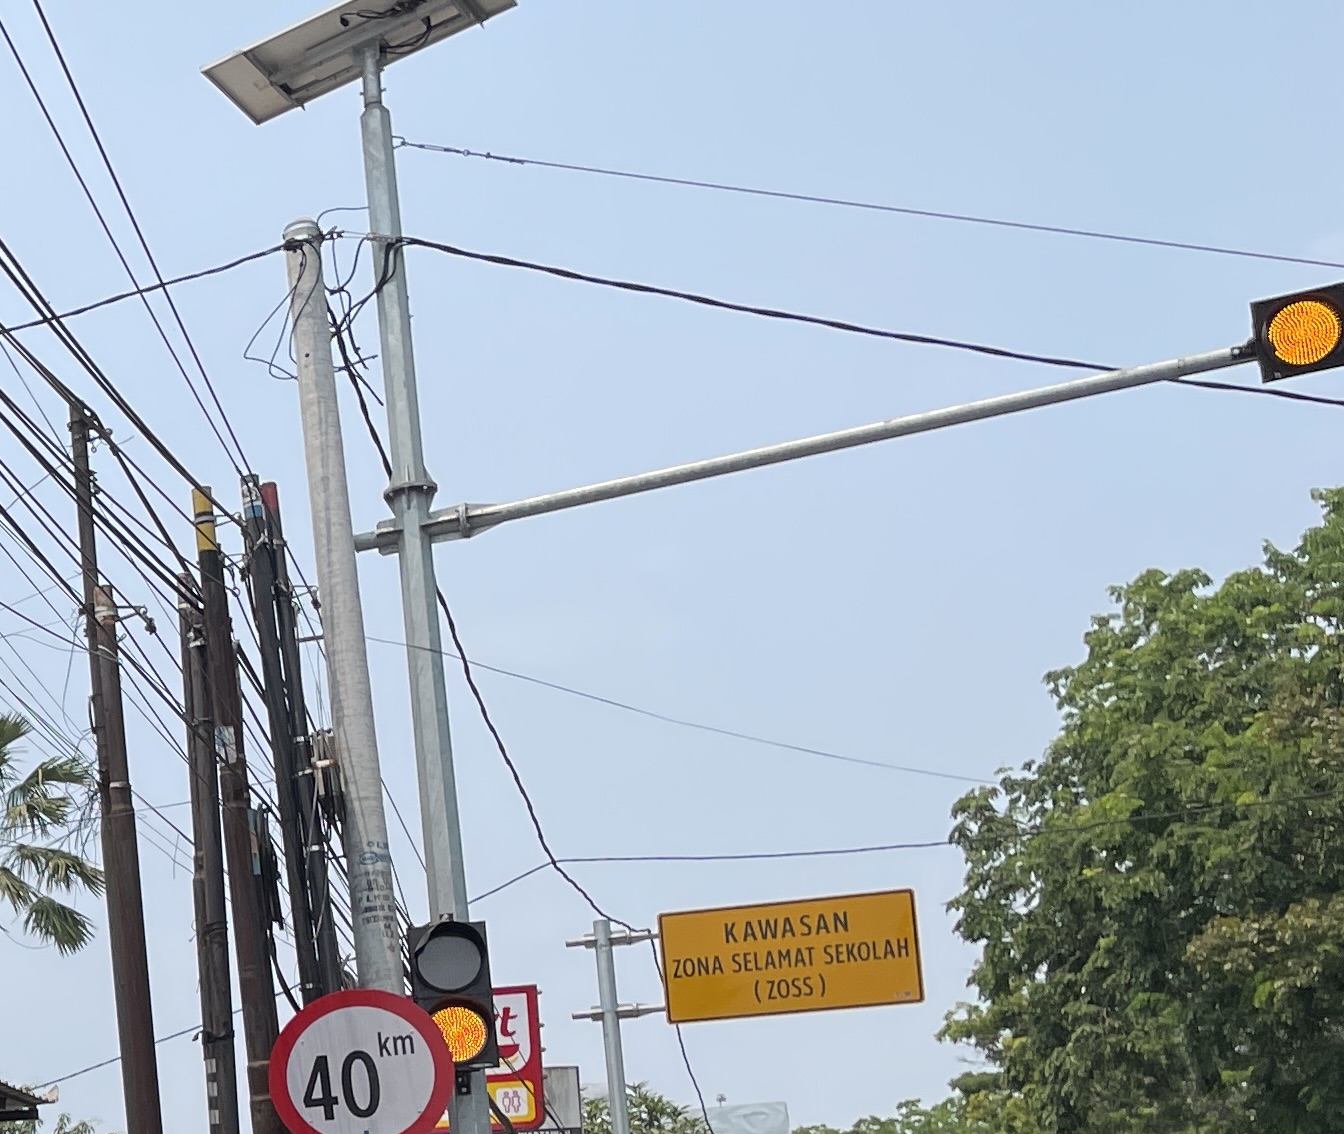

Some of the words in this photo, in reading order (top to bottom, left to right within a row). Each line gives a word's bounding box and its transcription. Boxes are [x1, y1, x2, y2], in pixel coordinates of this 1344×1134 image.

[724, 911, 849, 943] KAWASAN
[672, 955, 724, 978] ZONA
[732, 947, 815, 973] SELAMAT
[823, 937, 910, 965] SEKOLAH
[303, 1050, 381, 1121] 40
[377, 1031, 415, 1058] km
